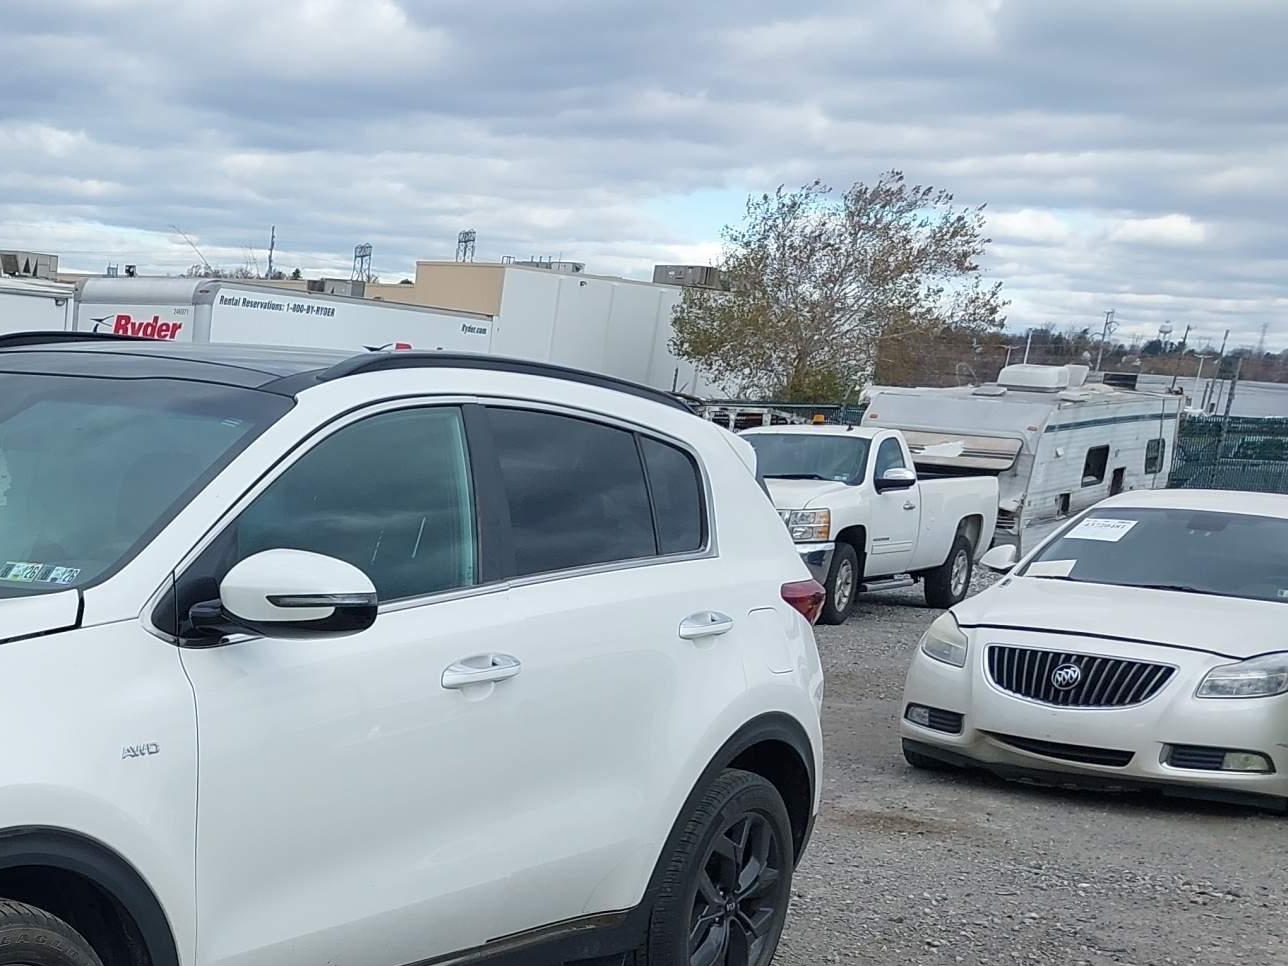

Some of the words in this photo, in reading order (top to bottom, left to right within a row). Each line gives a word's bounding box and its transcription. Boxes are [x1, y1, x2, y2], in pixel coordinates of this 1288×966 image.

[219, 295, 241, 306] Rental
[242, 297, 284, 312] Reservations:
[286, 303, 336, 317] 1-800-BY-RYDER
[461, 323, 487, 335] Ryder.com
[122, 742, 160, 760] AWD
